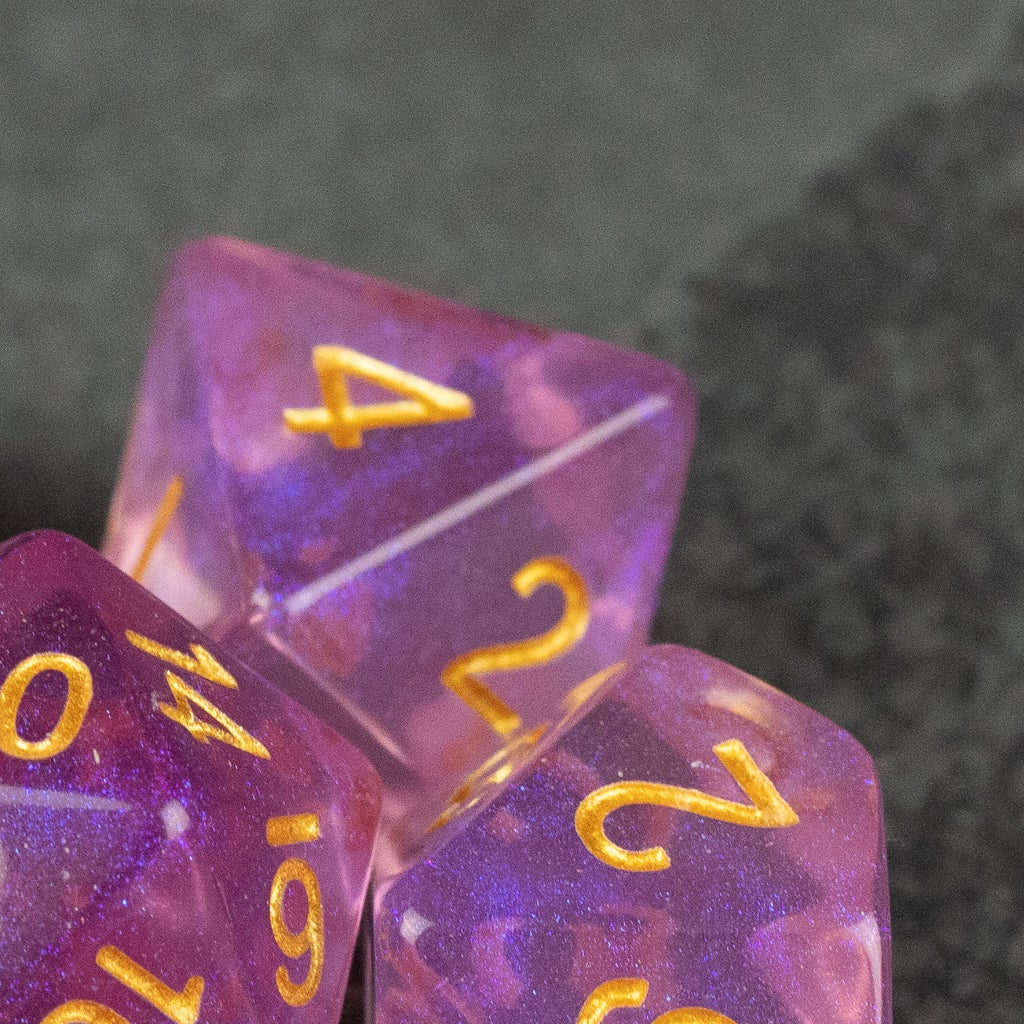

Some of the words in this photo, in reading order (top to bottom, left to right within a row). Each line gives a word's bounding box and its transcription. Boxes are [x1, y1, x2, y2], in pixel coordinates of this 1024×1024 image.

[283, 345, 474, 449] 4
[124, 629, 272, 761] 14
[440, 555, 590, 734] 2
[575, 738, 799, 872] 2
